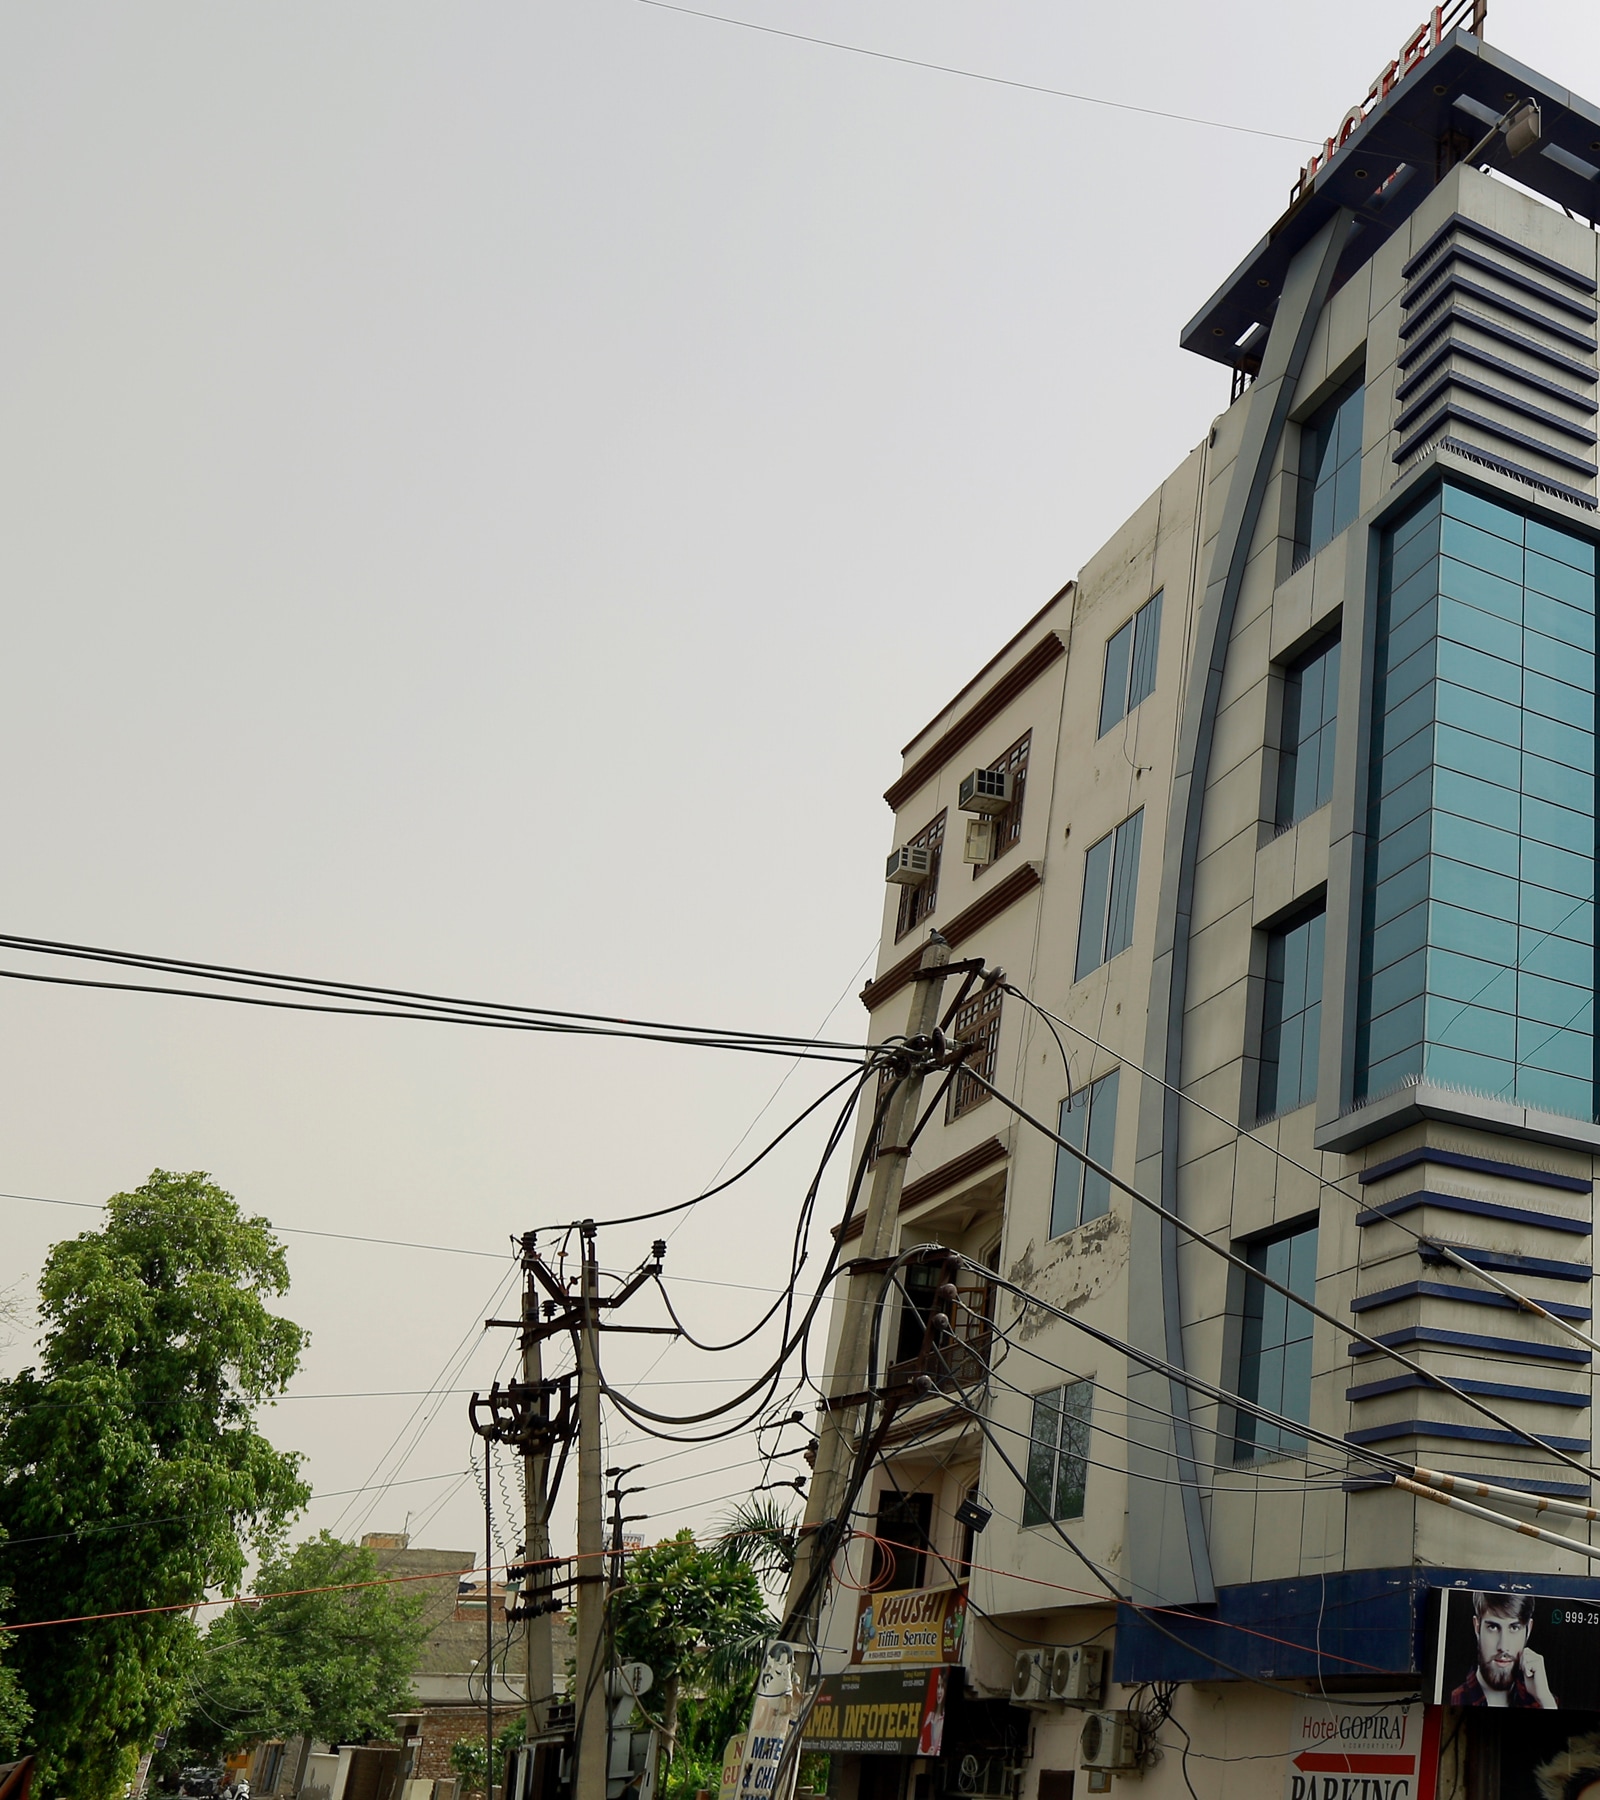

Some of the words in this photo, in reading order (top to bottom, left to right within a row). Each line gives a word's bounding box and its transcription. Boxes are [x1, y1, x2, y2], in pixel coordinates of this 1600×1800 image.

[877, 1591, 946, 1628] KHUSHI
[877, 1629, 900, 1648] Tiffin
[902, 1628, 938, 1646] Service
[801, 1704, 840, 1738] AMRA
[841, 1702, 922, 1738] INFOTECH
[1302, 1715, 1339, 1740] Hotel
[1339, 1715, 1409, 1751] GOPIRAJ
